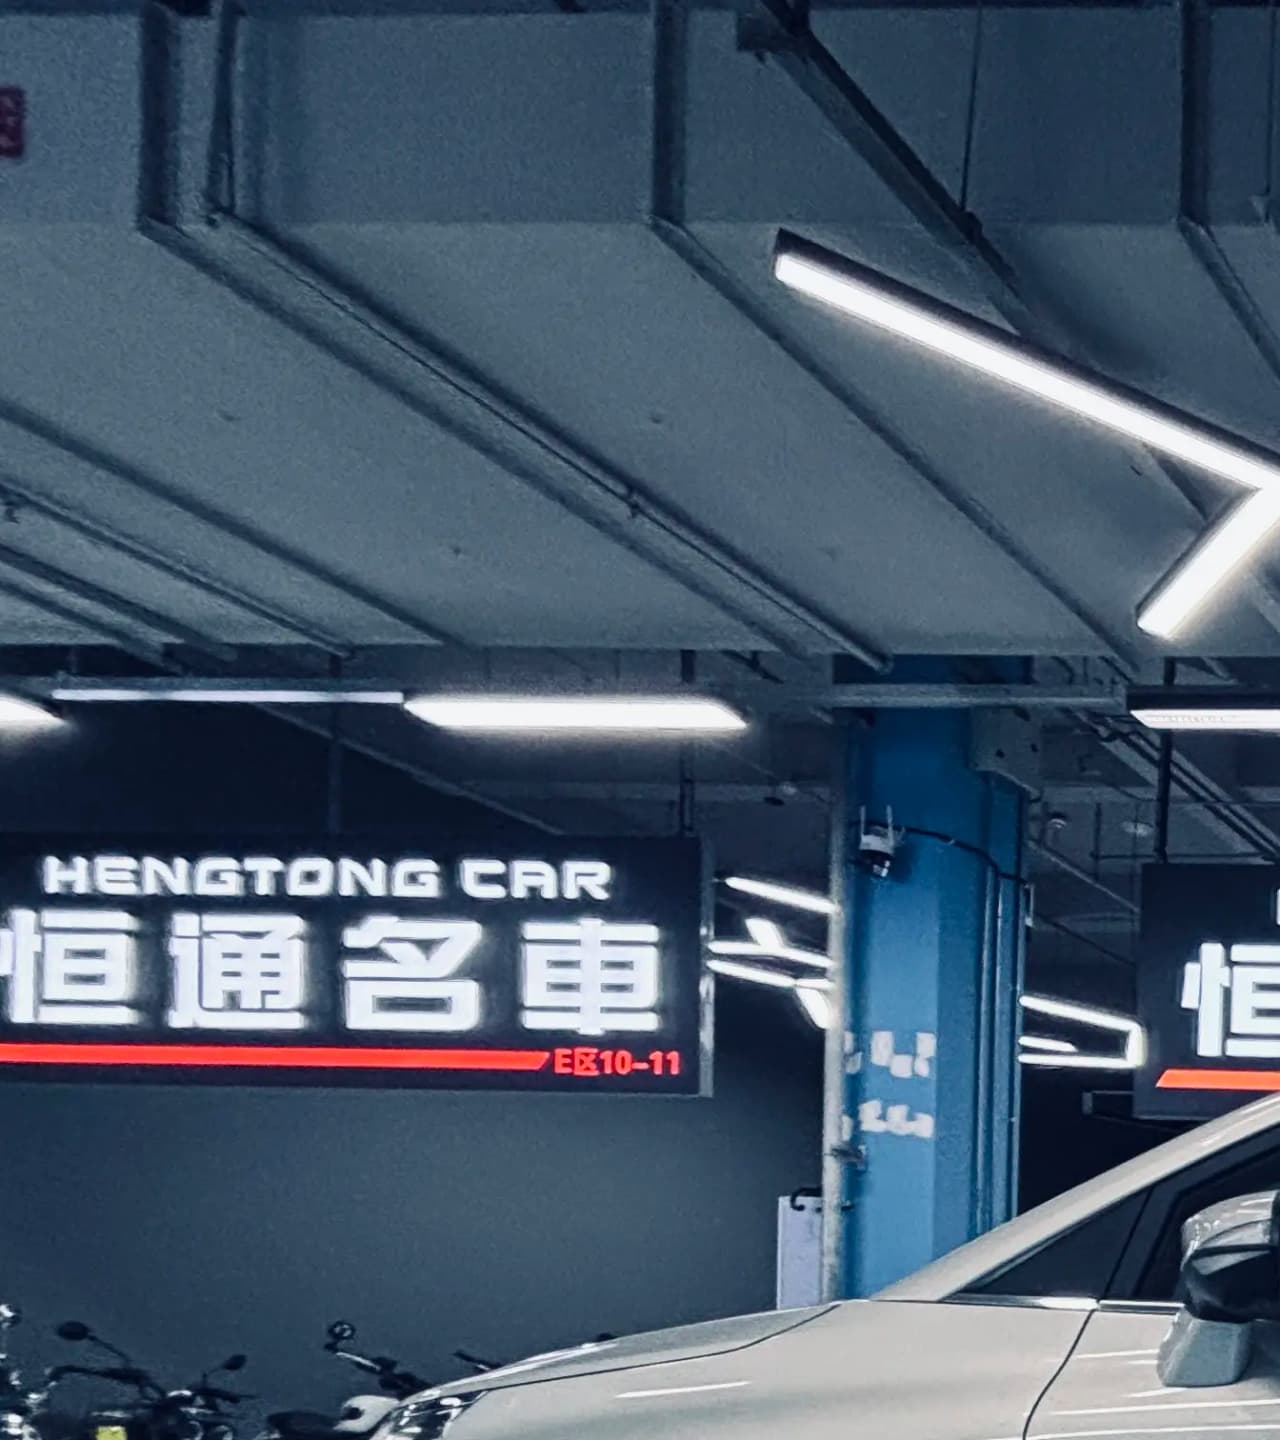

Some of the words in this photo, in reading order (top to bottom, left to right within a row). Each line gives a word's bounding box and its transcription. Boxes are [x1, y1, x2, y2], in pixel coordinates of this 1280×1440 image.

[43, 854, 442, 898] HENGTONG
[460, 858, 612, 901] CAR
[0, 909, 662, 1036] 恒通名車
[553, 1046, 680, 1077] E区10-11
